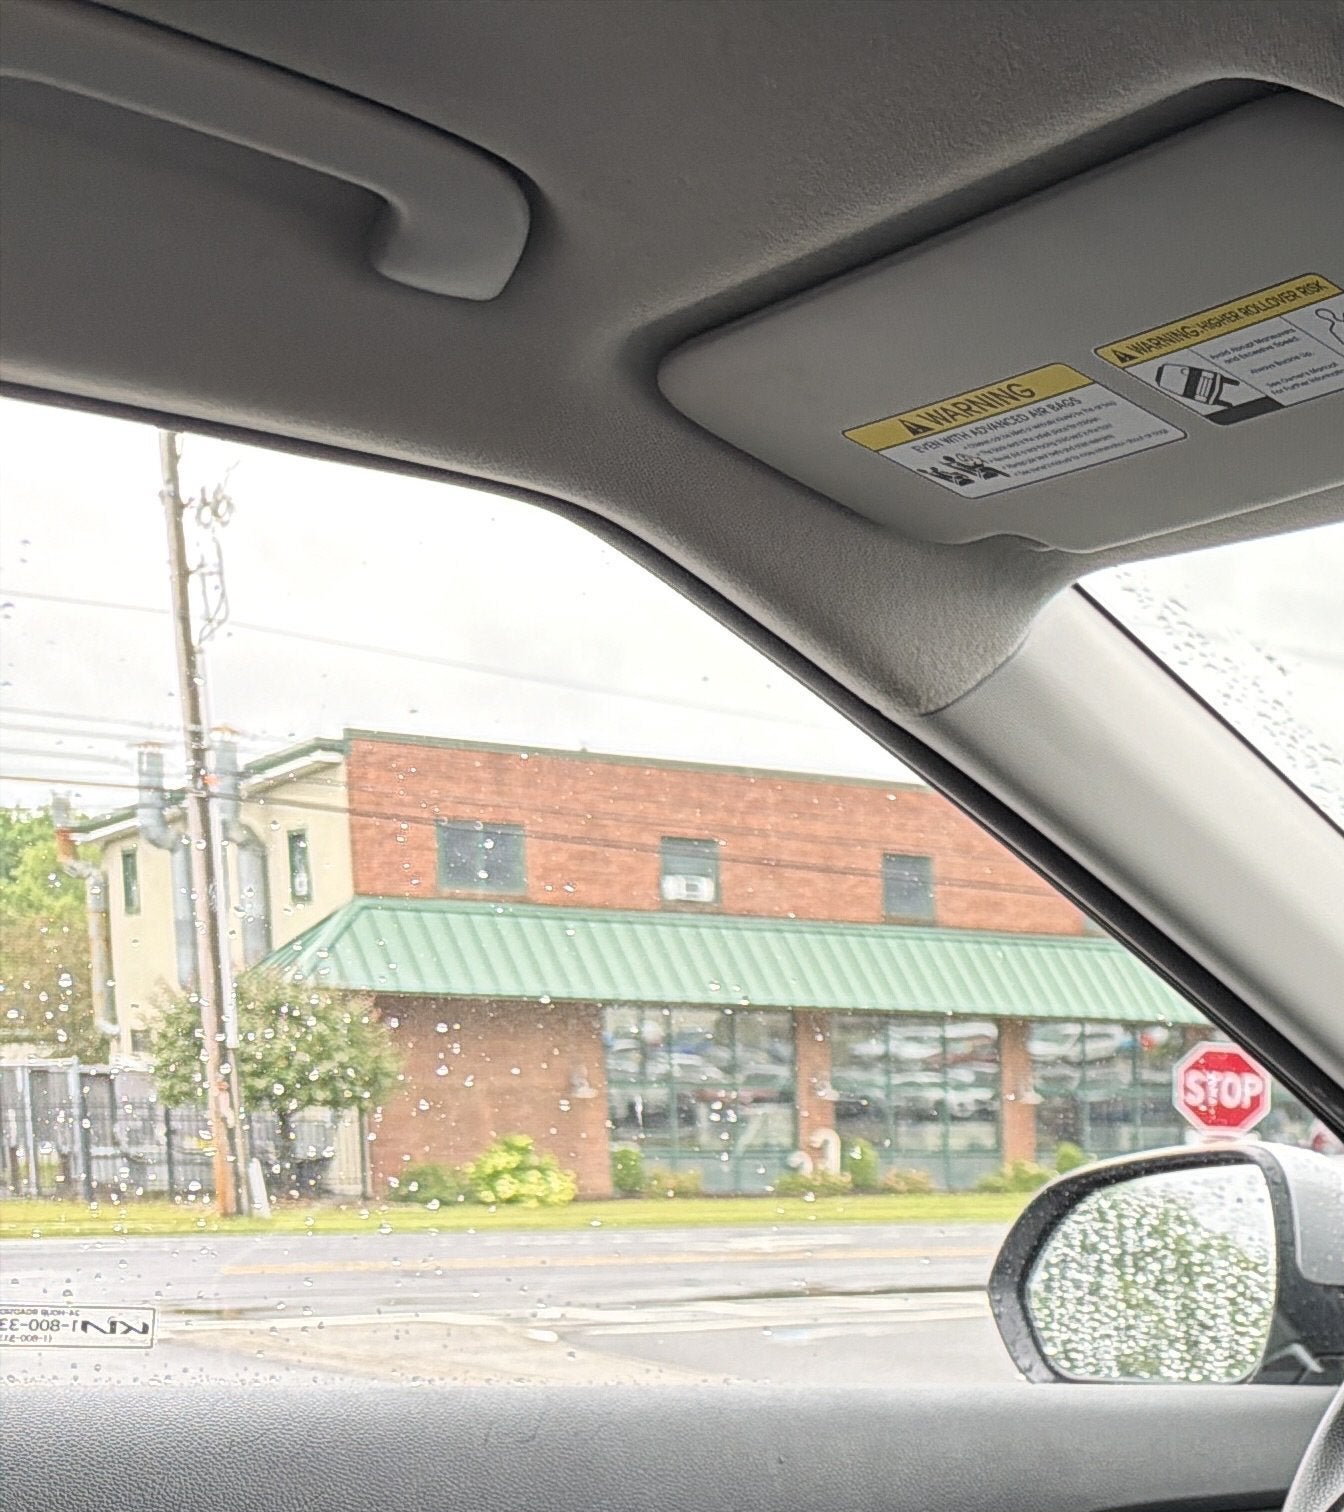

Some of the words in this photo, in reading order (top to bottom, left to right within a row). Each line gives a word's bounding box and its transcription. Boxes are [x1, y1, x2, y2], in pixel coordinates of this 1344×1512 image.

[1196, 311, 1244, 331] HIGHER
[1238, 290, 1300, 318] ROLLOVER
[1295, 280, 1328, 296] RISK
[911, 440, 943, 453] EVEN
[939, 432, 972, 444] WITH
[969, 414, 1029, 436] ADVANCED
[1028, 407, 1050, 418] AIR
[1046, 397, 1082, 412] BAGS
[916, 383, 1035, 426] WARNING
[1183, 1069, 1263, 1109] STOP
